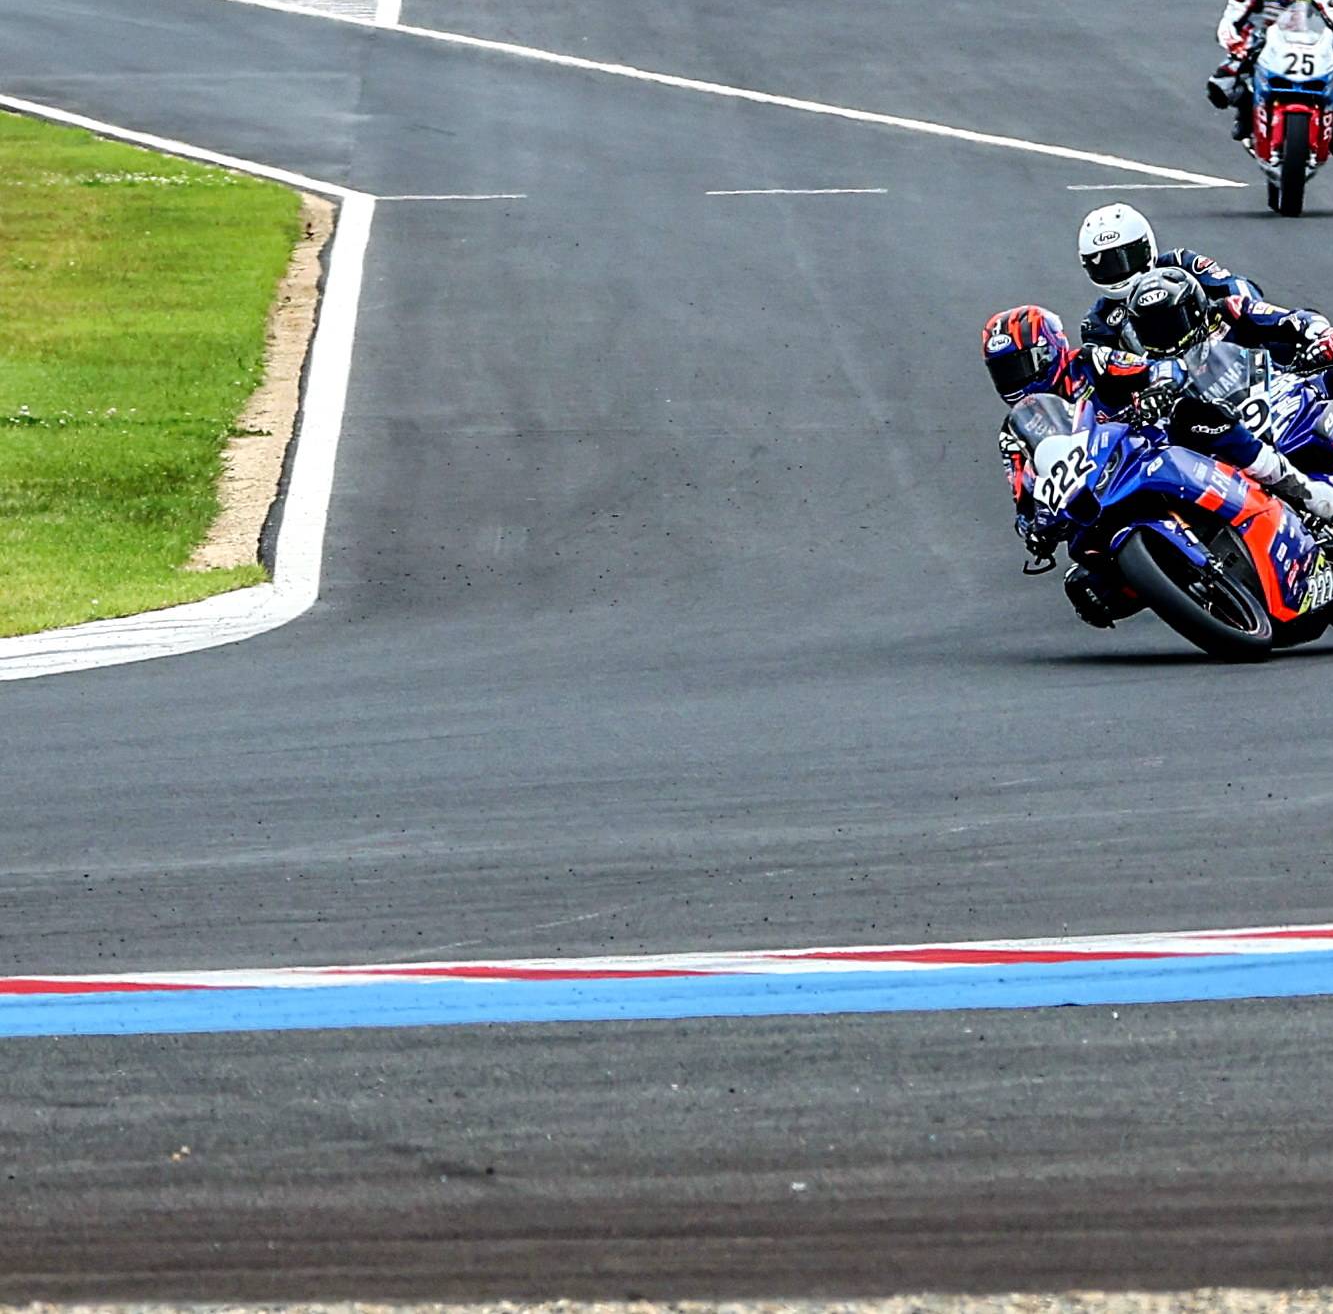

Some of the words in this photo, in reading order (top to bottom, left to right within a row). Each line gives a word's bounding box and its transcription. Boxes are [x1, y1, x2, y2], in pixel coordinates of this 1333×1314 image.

[1284, 52, 1315, 76] 25
[1202, 361, 1245, 401] AMAHA
[1042, 445, 1097, 511] 222
